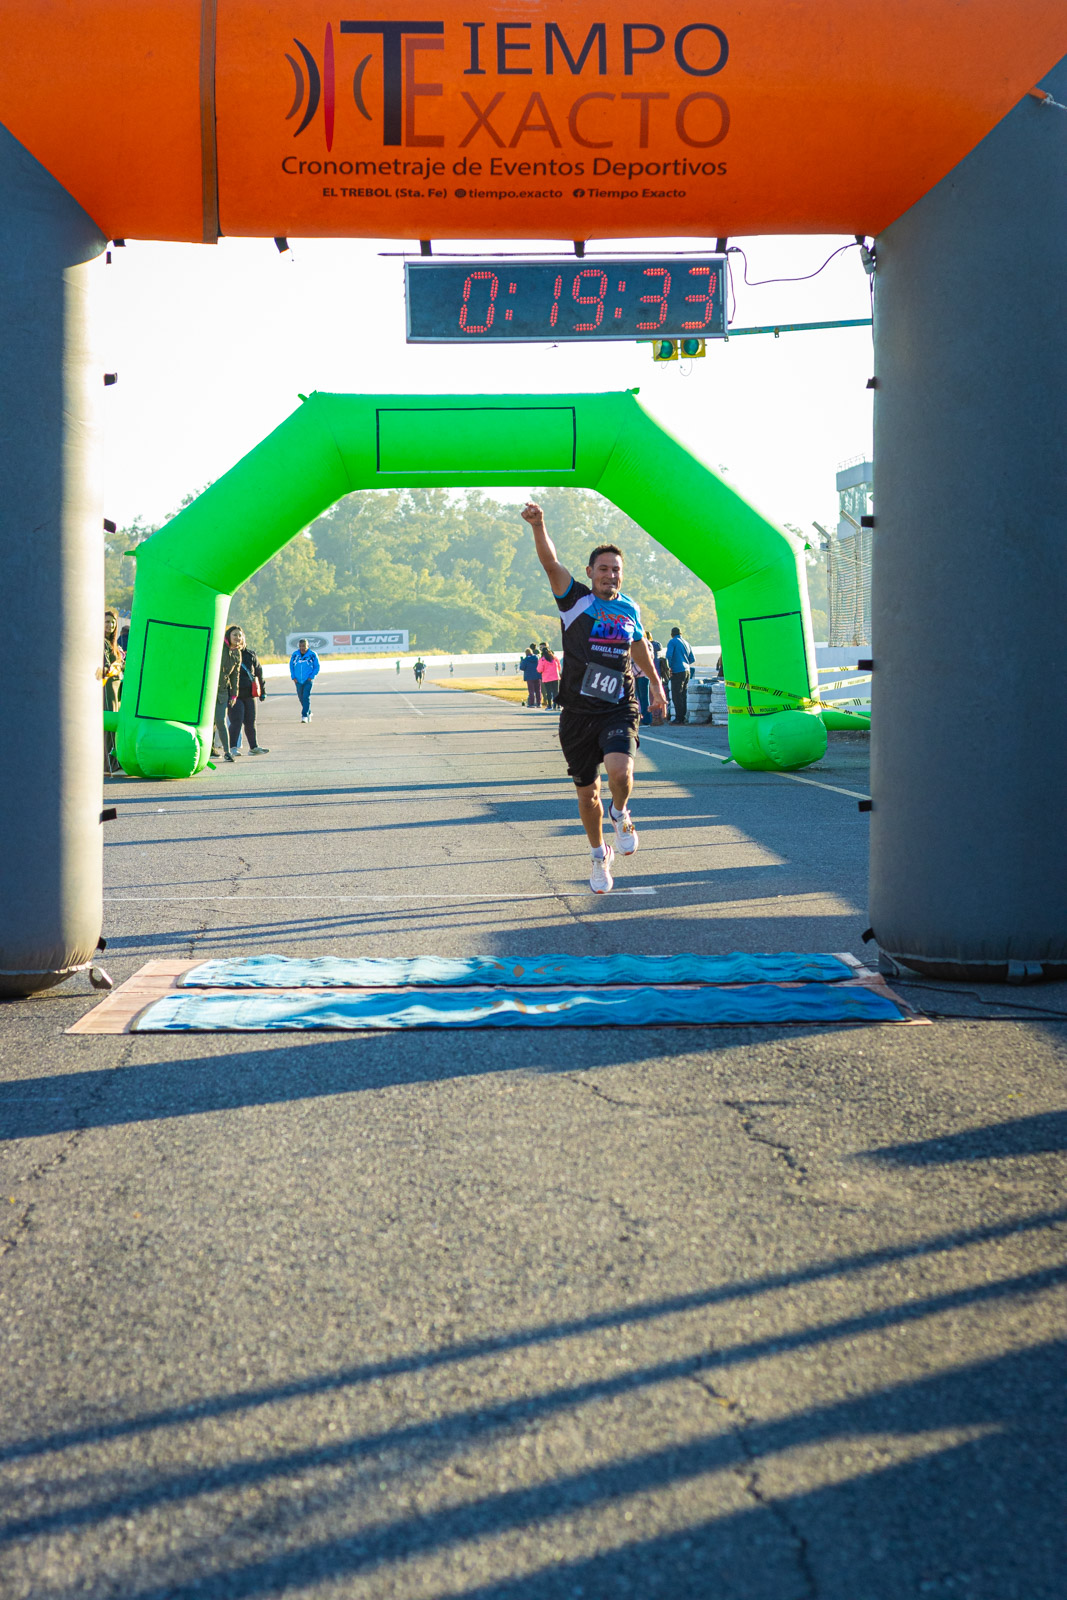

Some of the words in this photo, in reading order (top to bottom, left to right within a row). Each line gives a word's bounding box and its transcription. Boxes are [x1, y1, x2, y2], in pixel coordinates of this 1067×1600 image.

[281, 156, 446, 180] Cronometraje
[452, 156, 482, 176] de
[490, 157, 585, 176] Eventos
[593, 157, 728, 180] Deportivos
[323, 188, 338, 197] EL
[340, 188, 392, 197] TREBOL
[395, 187, 425, 199] (Sta.
[428, 187, 448, 199] Fe)
[469, 188, 563, 200] tiempo.exacto
[587, 188, 639, 200] Tiempo
[642, 188, 687, 198] Exacto
[354, 635, 400, 644] LONG
[591, 672, 618, 694] 140
